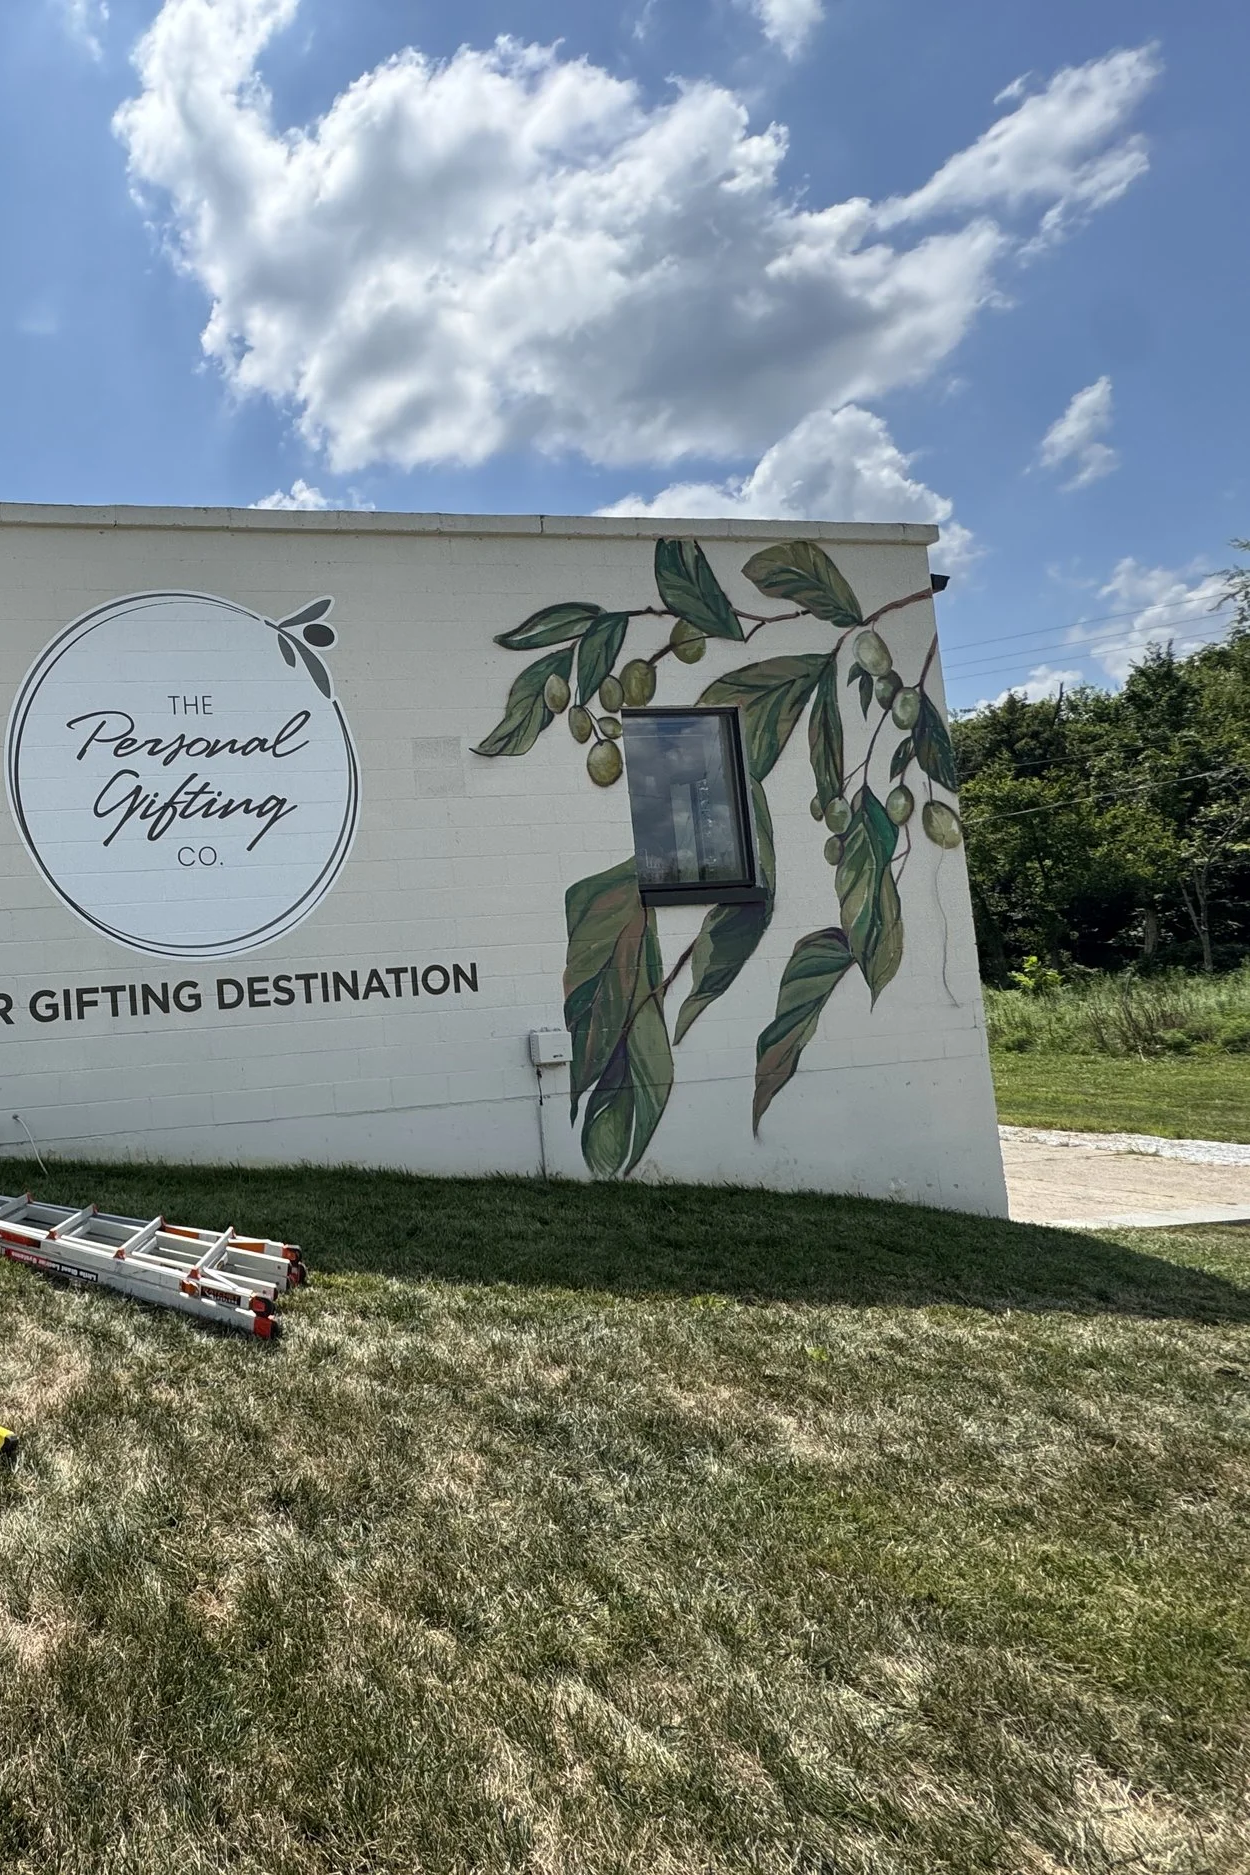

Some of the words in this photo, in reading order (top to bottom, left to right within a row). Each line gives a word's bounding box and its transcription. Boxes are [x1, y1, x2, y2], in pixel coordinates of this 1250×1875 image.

[167, 695, 214, 716] THE
[66, 710, 311, 767] Personal
[93, 769, 298, 852] Gifting
[177, 846, 224, 867] CO.
[28, 980, 202, 1023] GIFTING
[216, 962, 479, 1010] DESTINATION
